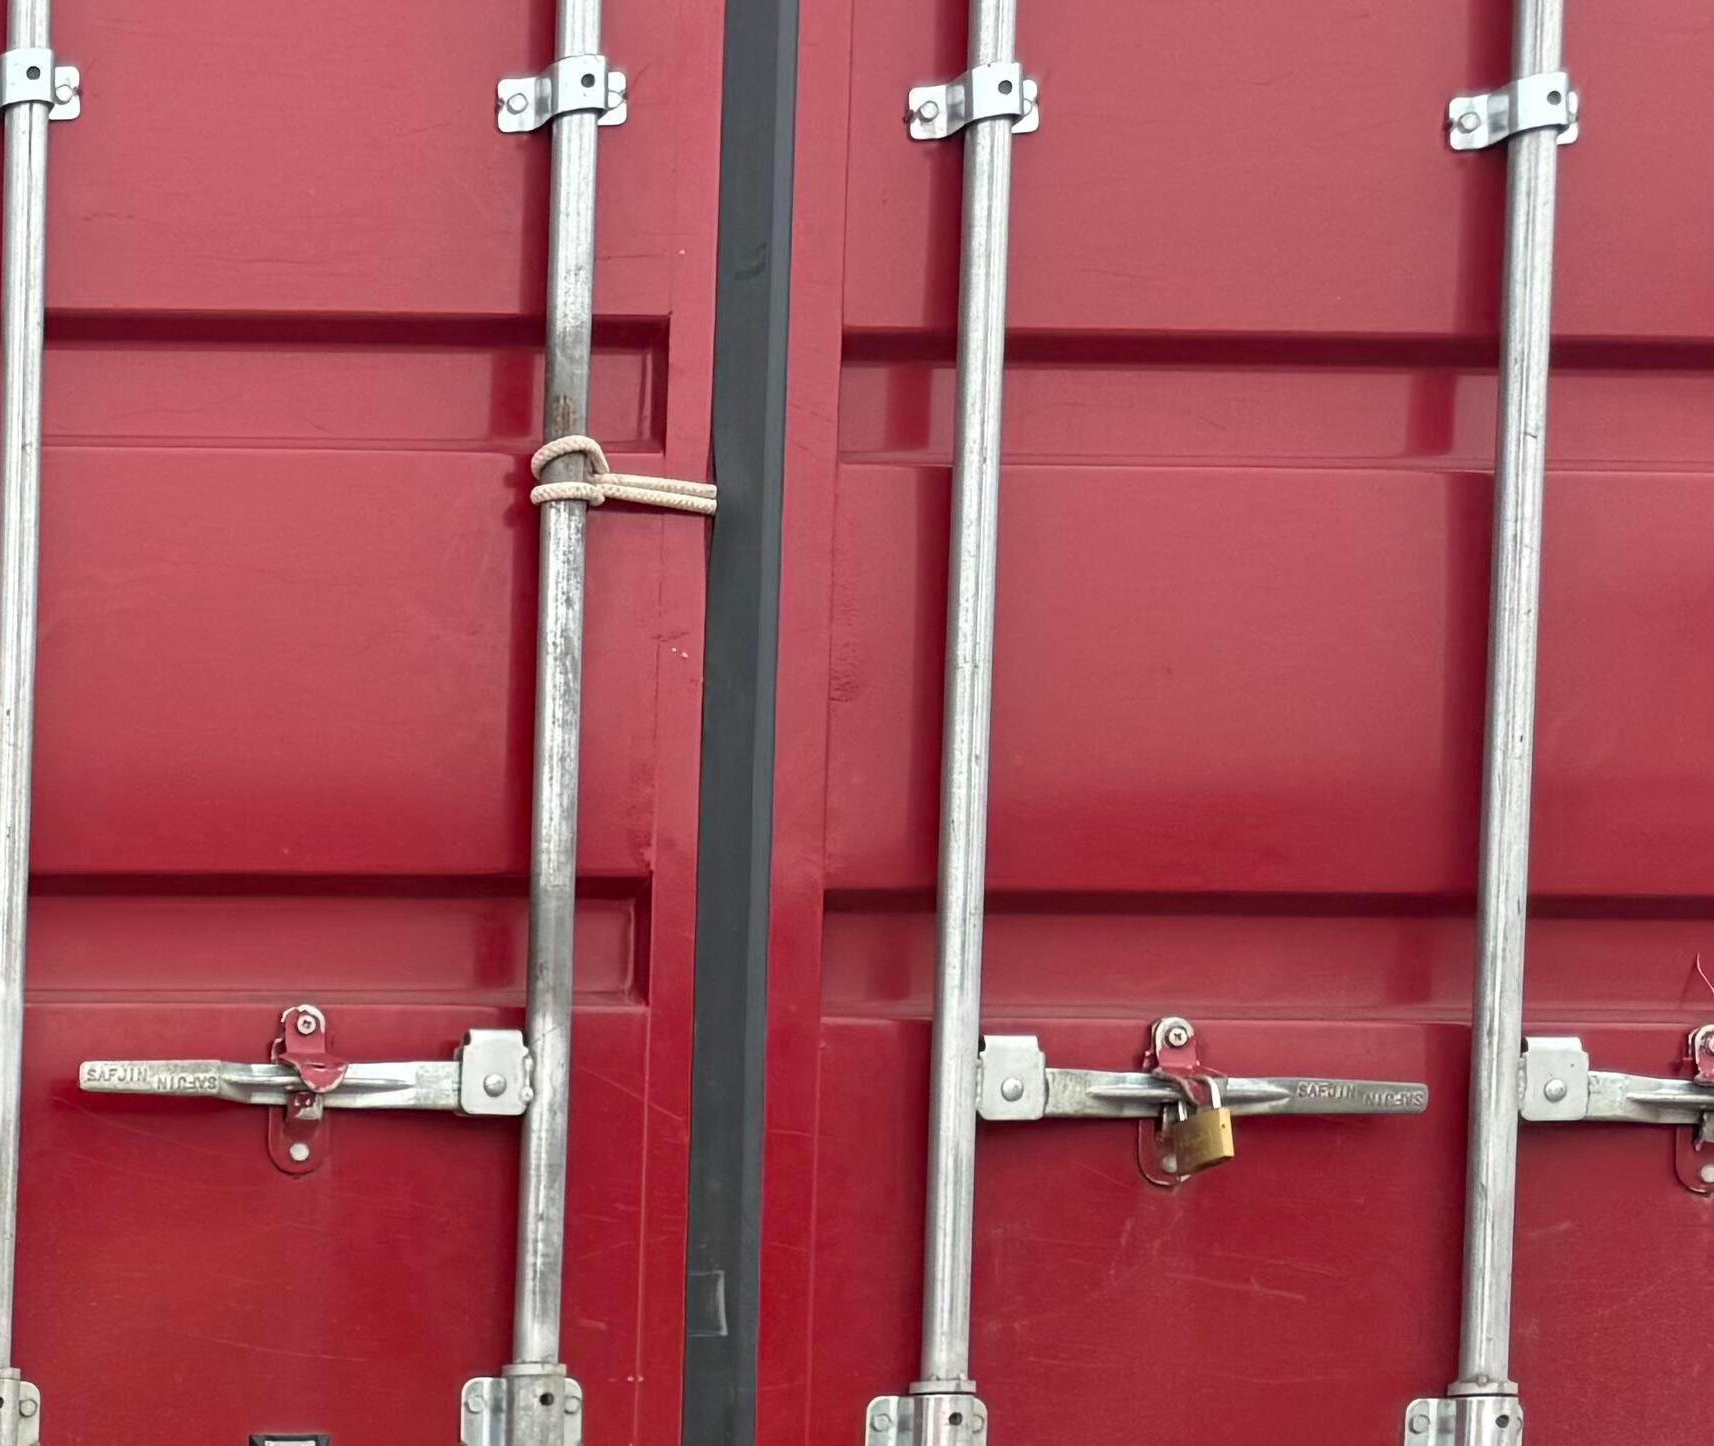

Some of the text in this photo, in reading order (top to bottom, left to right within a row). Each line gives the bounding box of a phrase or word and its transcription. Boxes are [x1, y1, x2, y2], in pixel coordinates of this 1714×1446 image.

[86, 1066, 149, 1083] SAFJIN
[156, 1074, 219, 1092] SAFJIN
[1296, 1081, 1357, 1100] SAFJIN
